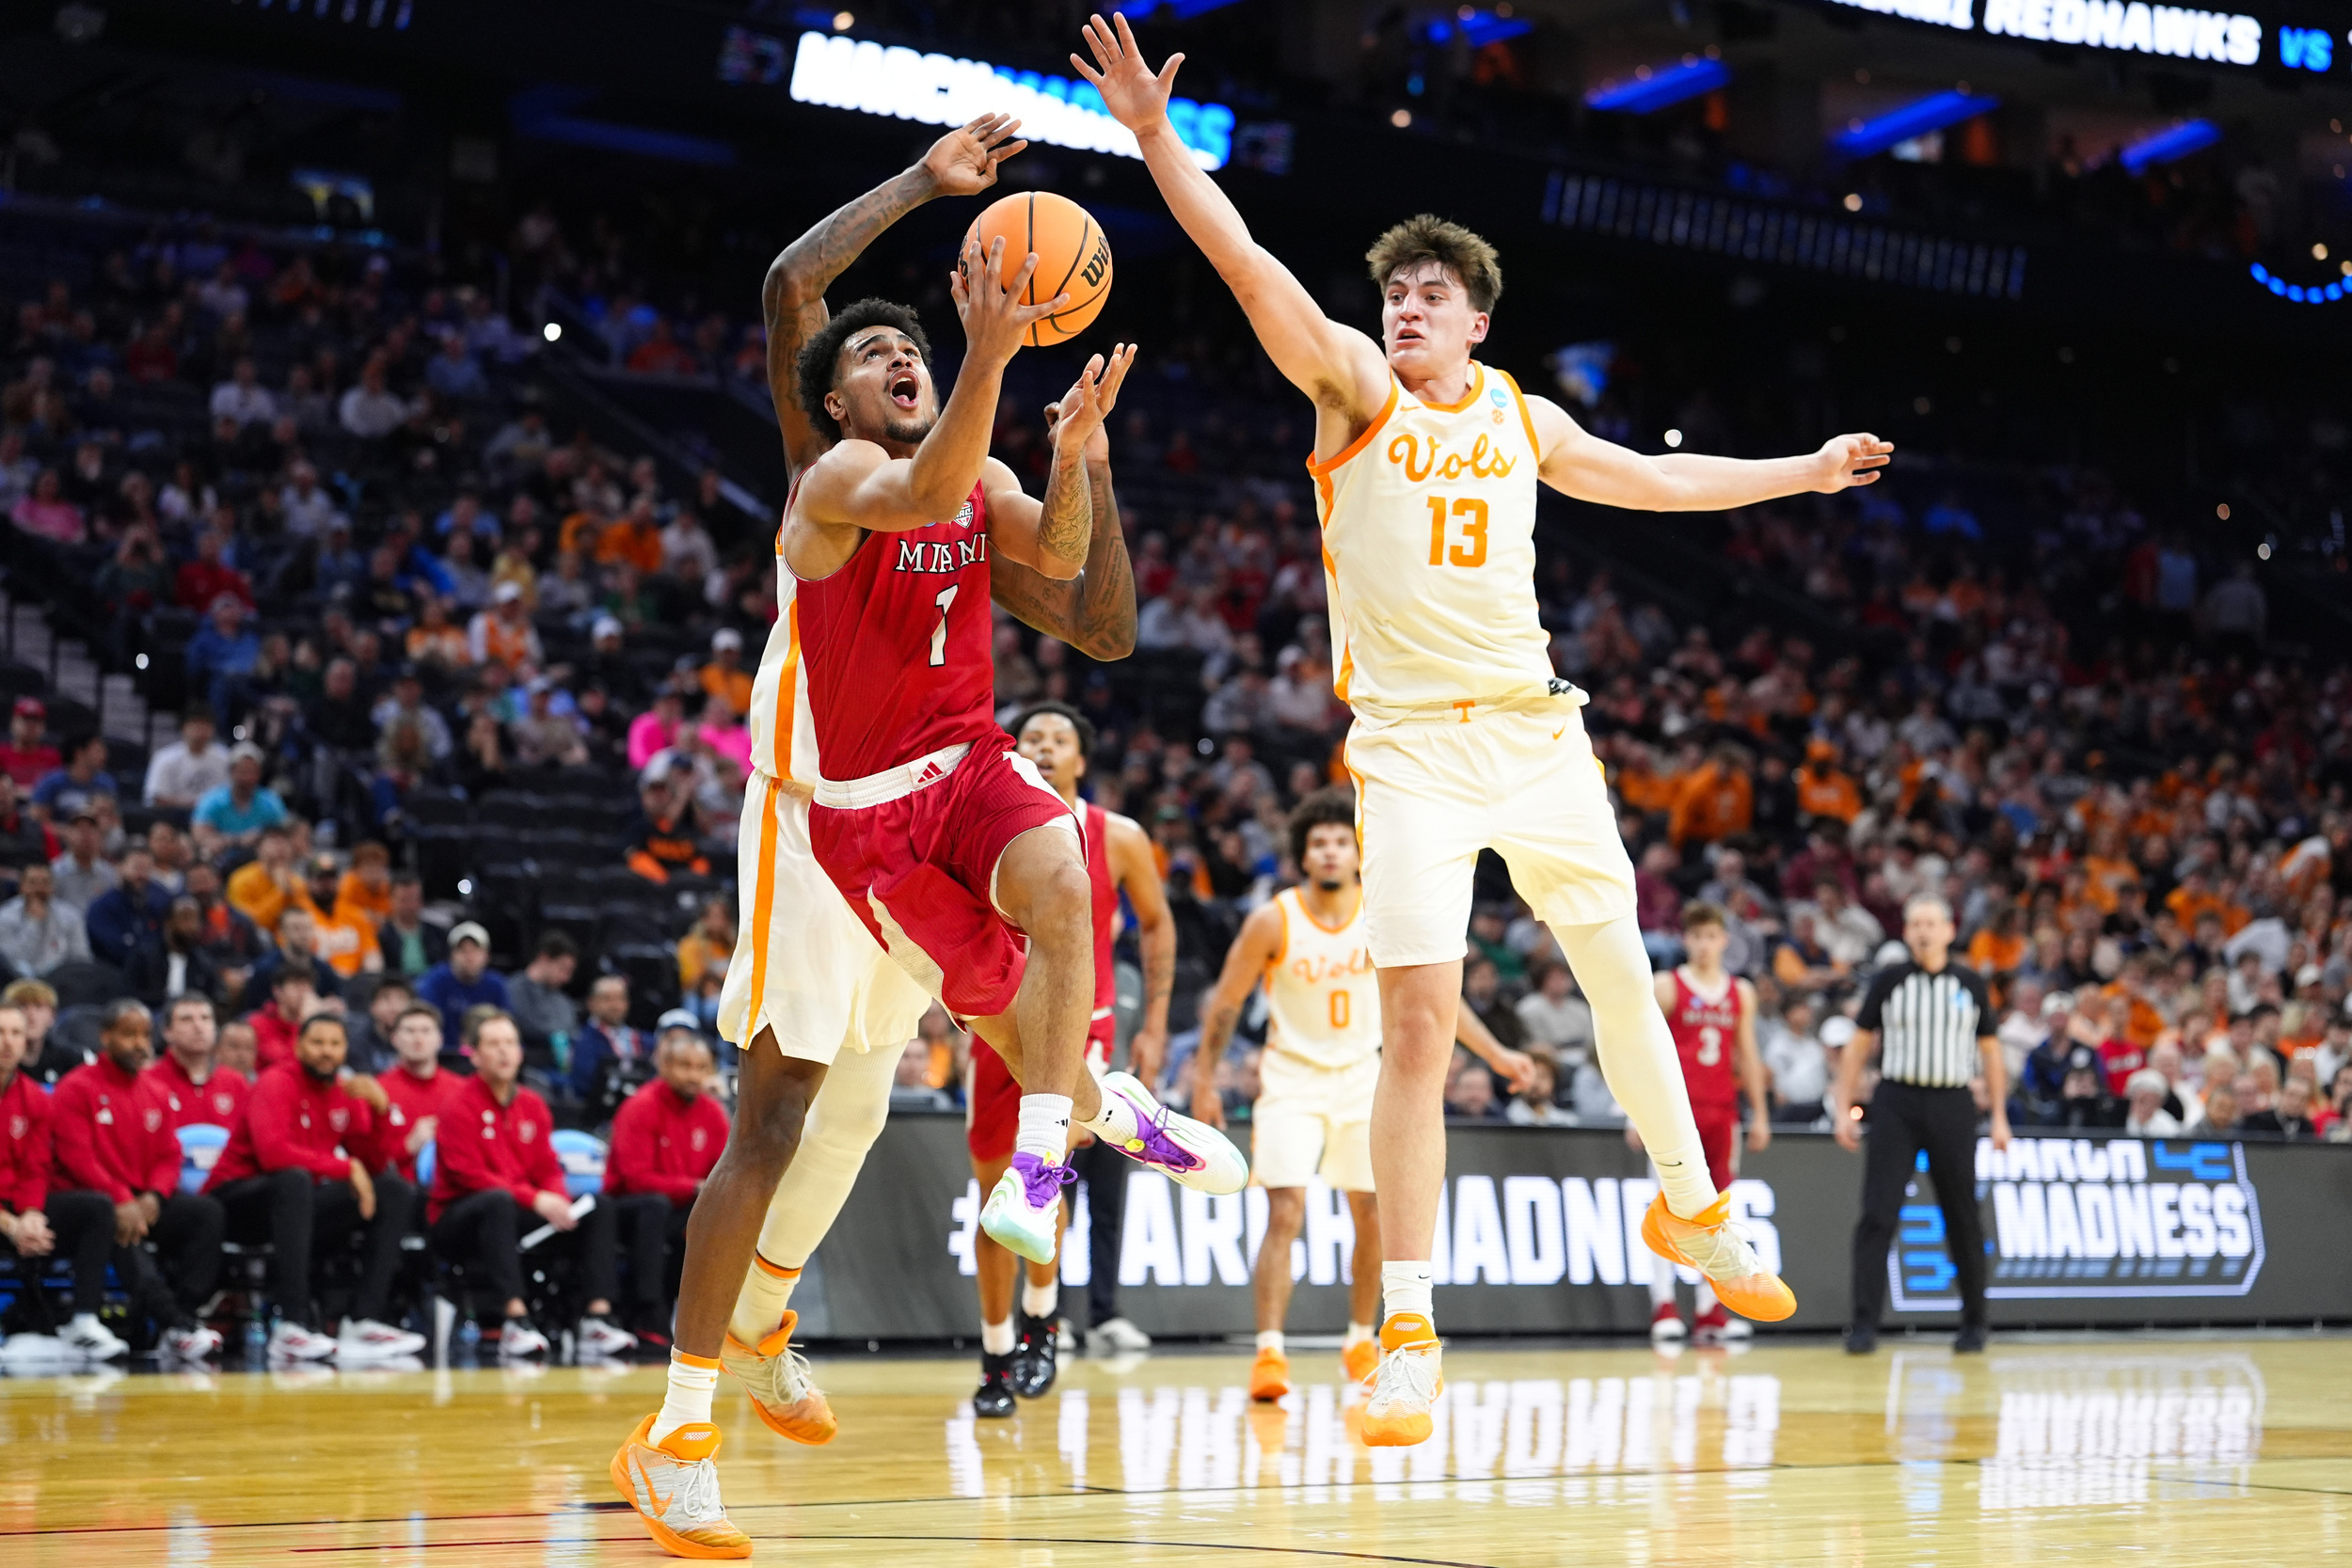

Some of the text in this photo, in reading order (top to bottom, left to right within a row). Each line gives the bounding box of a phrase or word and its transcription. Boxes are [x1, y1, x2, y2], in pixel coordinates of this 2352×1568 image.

[1983, 0, 2263, 66] REDHAWKS
[2279, 25, 2334, 71] VS
[1388, 433, 1518, 483] Vols
[1426, 495, 1489, 568] 13
[929, 582, 960, 667] 1
[1453, 700, 1476, 723] T
[1291, 948, 1375, 984] Vol
[1328, 990, 1350, 1029] 0
[1696, 1025, 1723, 1068] 3
[1992, 1181, 2254, 1259] MADNESS
